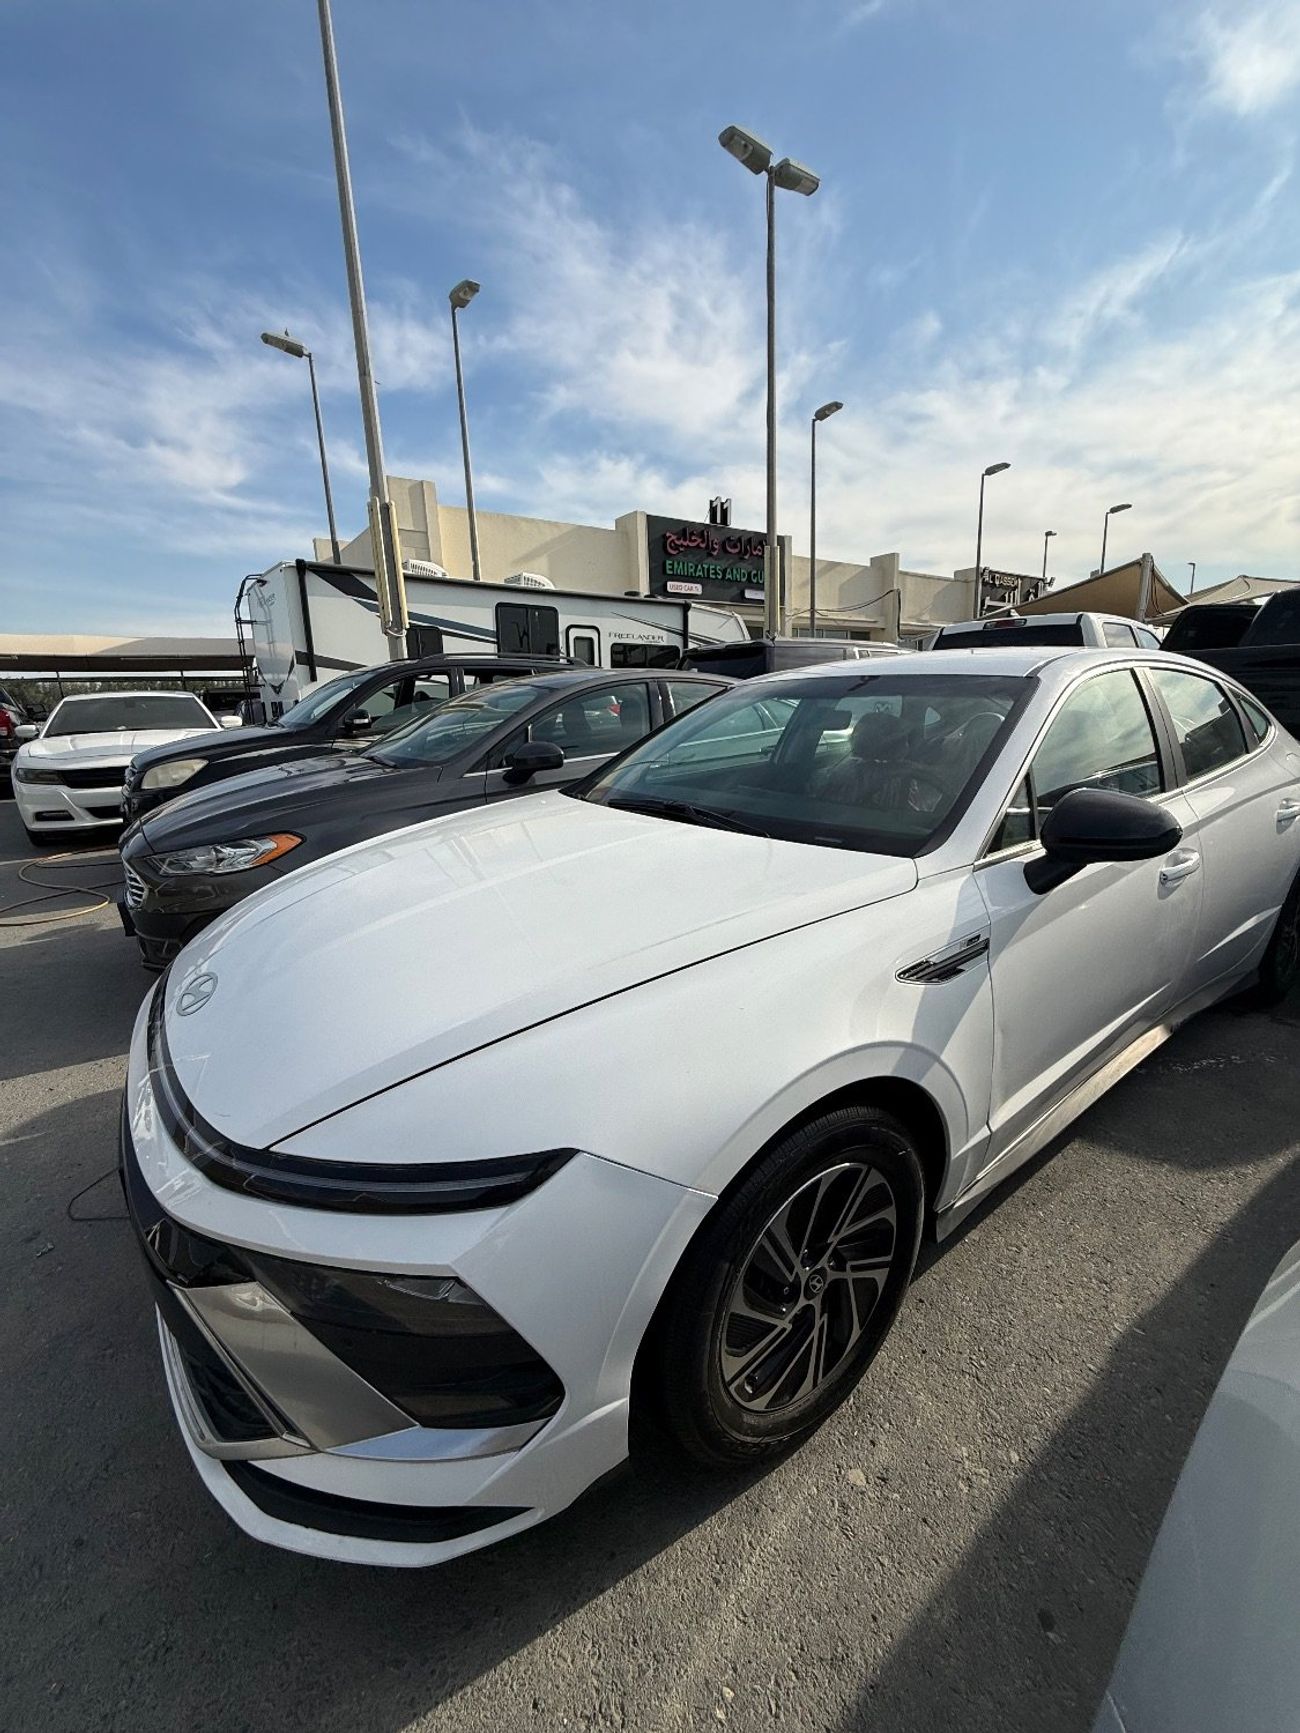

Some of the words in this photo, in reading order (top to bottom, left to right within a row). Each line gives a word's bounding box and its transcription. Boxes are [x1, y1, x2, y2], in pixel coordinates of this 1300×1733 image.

[711, 496, 732, 526] 11
[665, 527, 720, 556] والخليج
[665, 559, 722, 579] EMIRATES
[725, 567, 748, 582] AND
[751, 570, 764, 584] GU
[608, 632, 665, 642] FREELANDER
